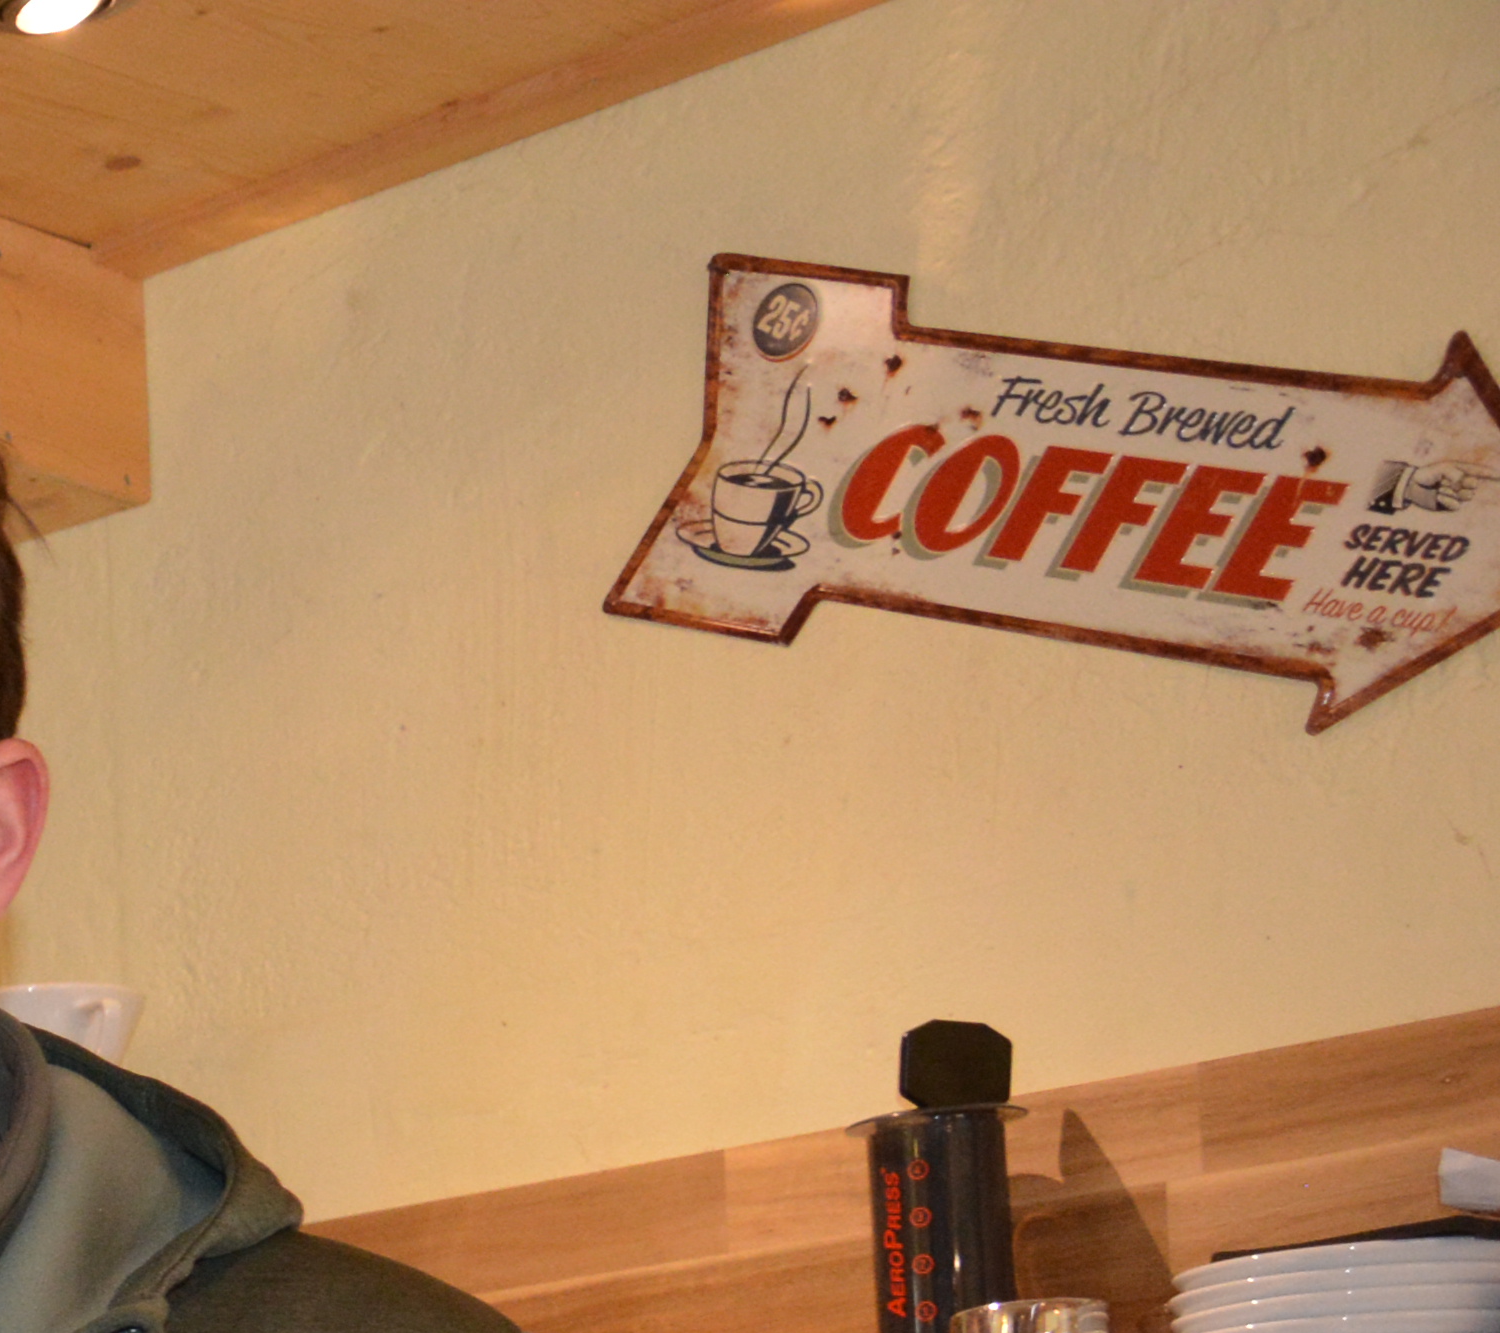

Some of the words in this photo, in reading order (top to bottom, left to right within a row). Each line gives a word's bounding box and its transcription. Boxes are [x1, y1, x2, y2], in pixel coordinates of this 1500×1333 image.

[991, 376, 1111, 429] Fresh
[1120, 389, 1299, 451] Brewed
[834, 422, 1350, 602] COFFEE
[1343, 523, 1471, 563] SERVED
[1340, 555, 1452, 598] HERE
[1303, 588, 1365, 621] Have
[1366, 605, 1388, 625] a
